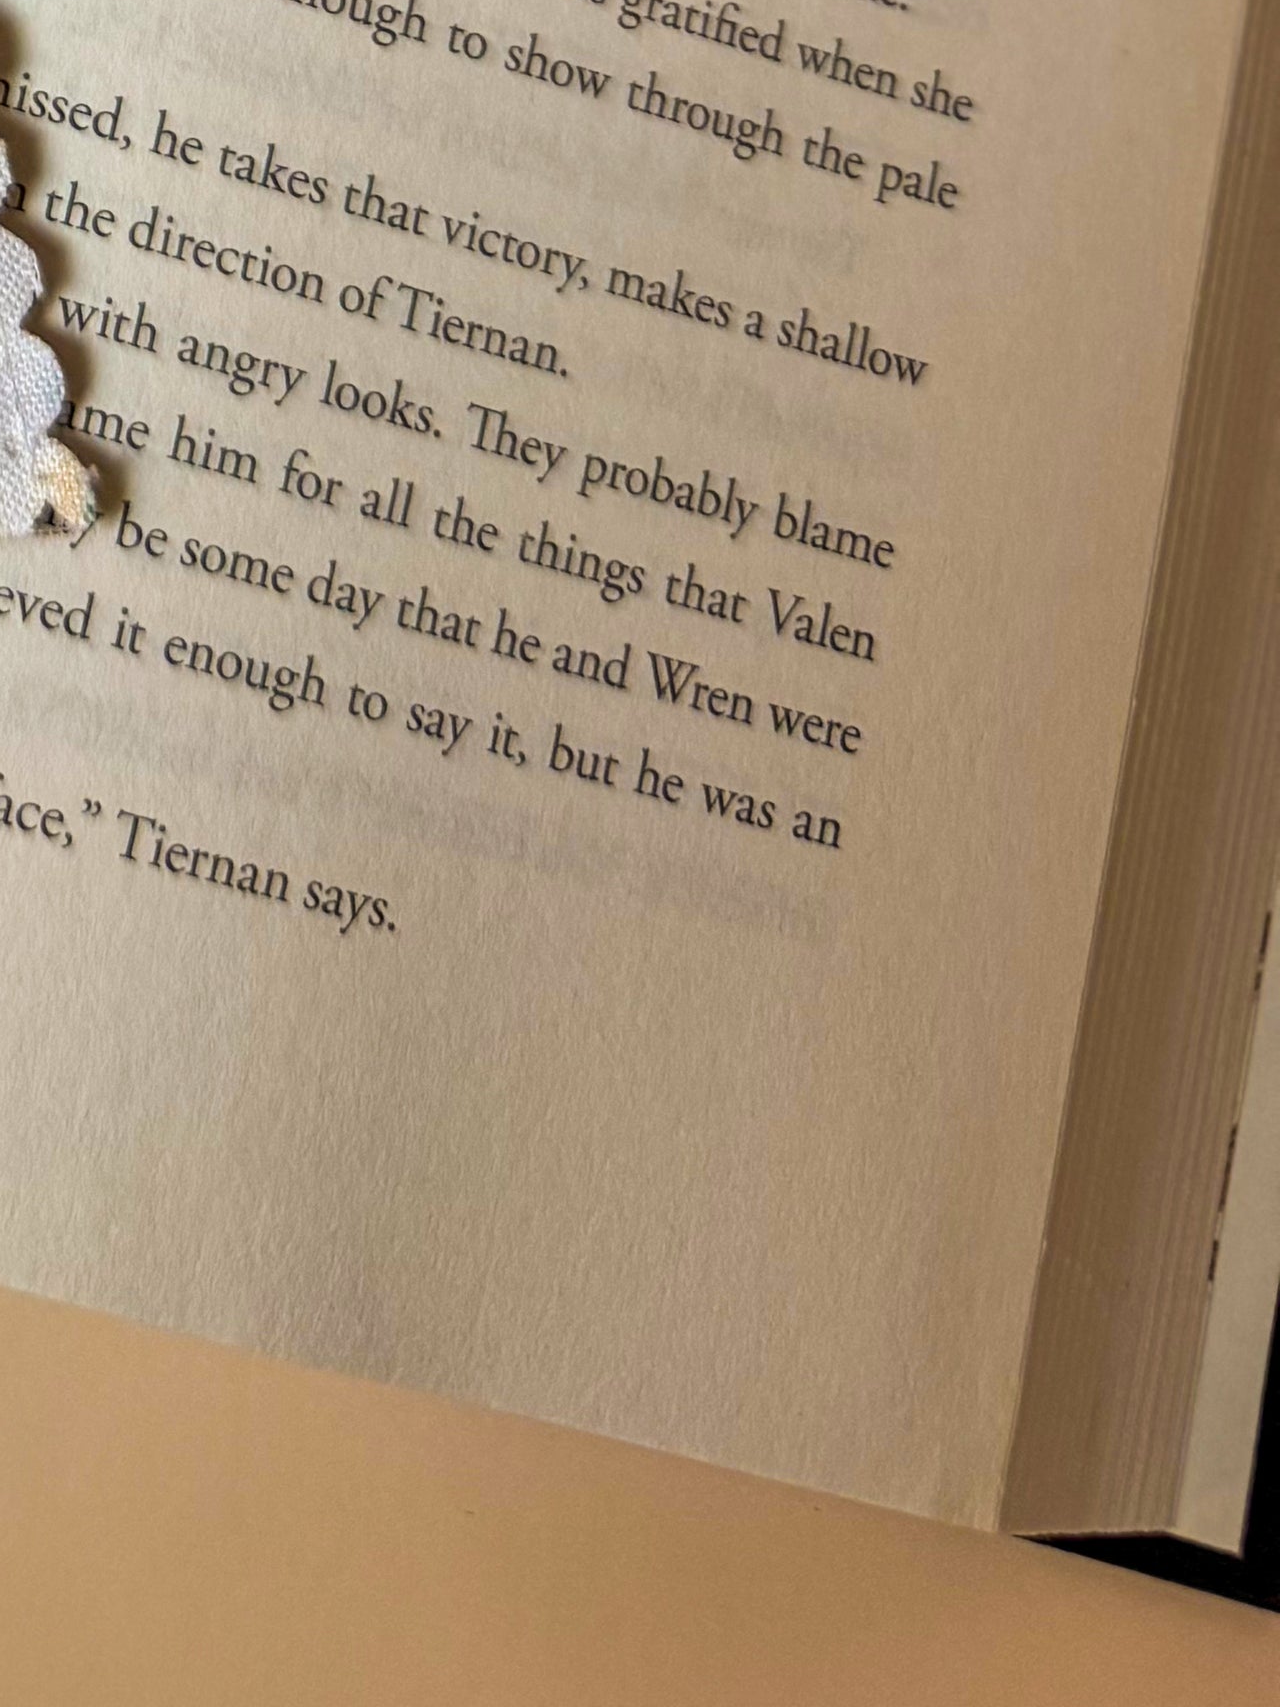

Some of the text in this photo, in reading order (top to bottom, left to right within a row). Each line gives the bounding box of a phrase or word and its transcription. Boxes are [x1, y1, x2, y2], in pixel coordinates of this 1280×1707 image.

[797, 37, 899, 100] when
[910, 68, 975, 123] she
[45, 180, 568, 379] the direction of Tiernan.
[149, 109, 929, 387] he takes that victory, makes a shallow
[57, 293, 895, 570] with angry looks. They probably blame
[113, 497, 862, 756] be some day that he and Wren were
[116, 808, 289, 903] Tiernan
[302, 880, 396, 936] says.
